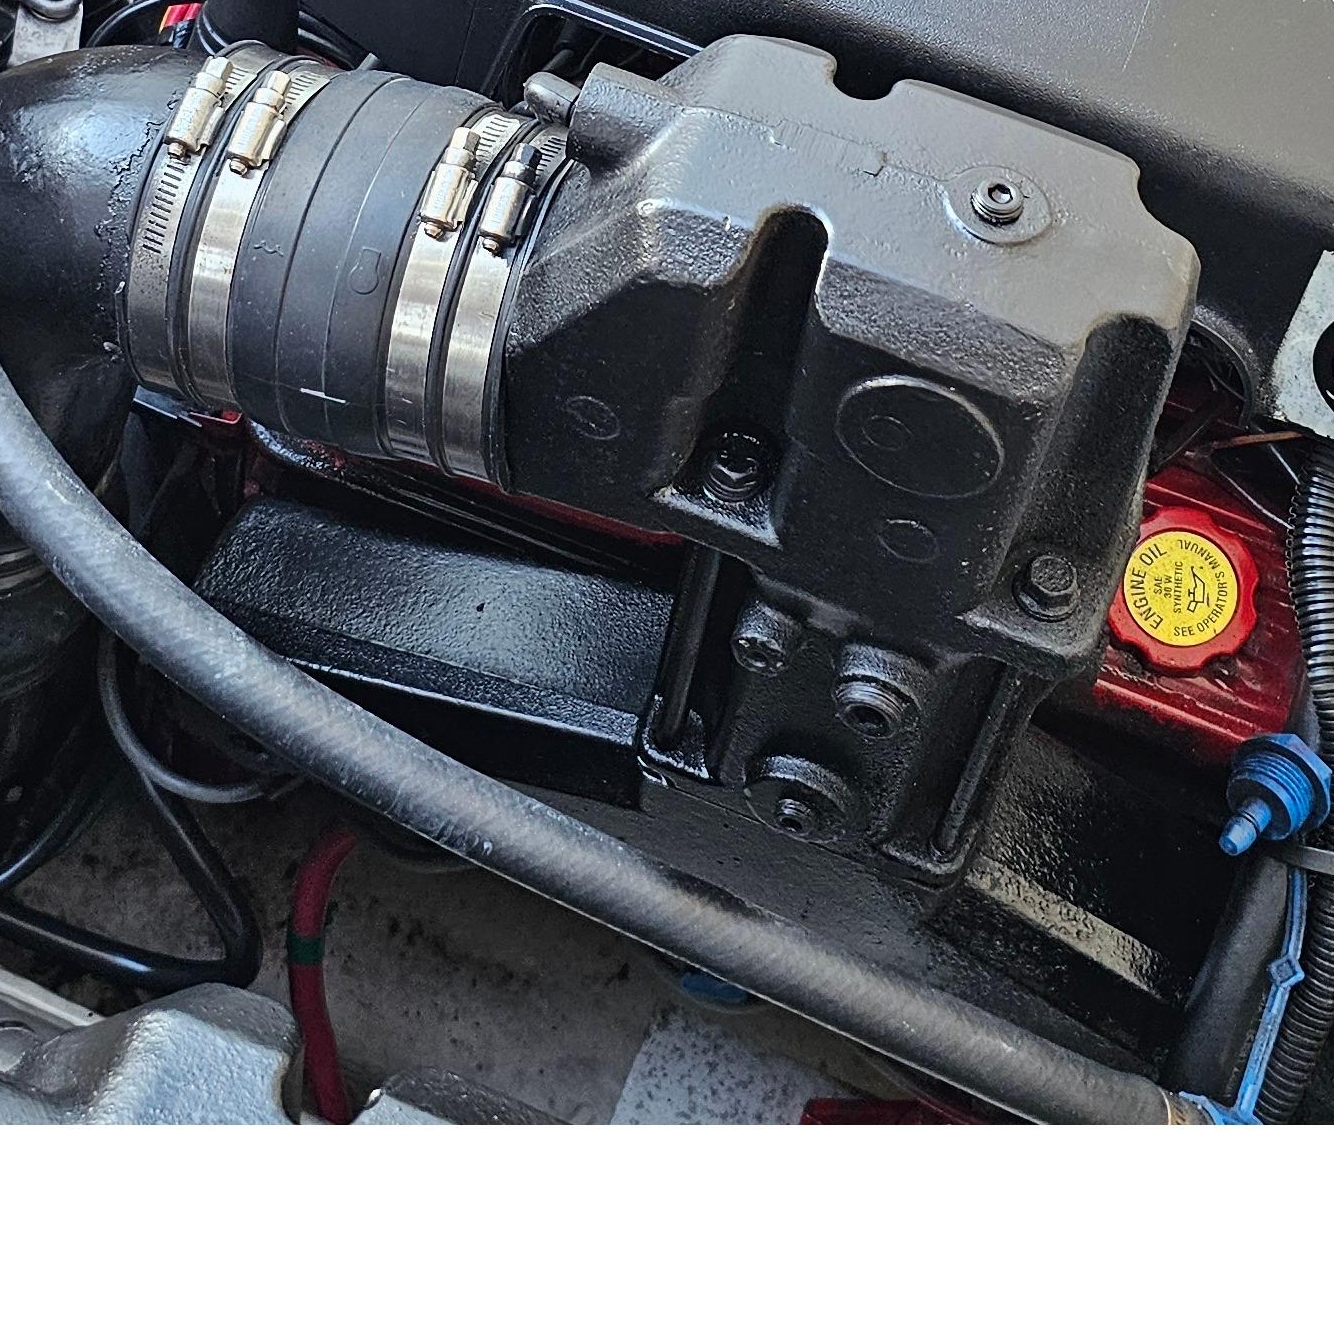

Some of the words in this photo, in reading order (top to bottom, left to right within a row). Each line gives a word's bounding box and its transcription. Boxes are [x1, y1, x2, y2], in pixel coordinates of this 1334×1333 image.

[1139, 543, 1168, 566] OIL
[1178, 539, 1221, 570] MANUAL
[1153, 576, 1163, 595] SAE
[1164, 574, 1173, 585] W
[1173, 561, 1184, 614] SYNTHETIC
[1130, 567, 1164, 630] ENGINE
[1163, 586, 1173, 599] 30
[1196, 571, 1228, 632] OPERATOR'S
[1173, 625, 1196, 637] SEE
